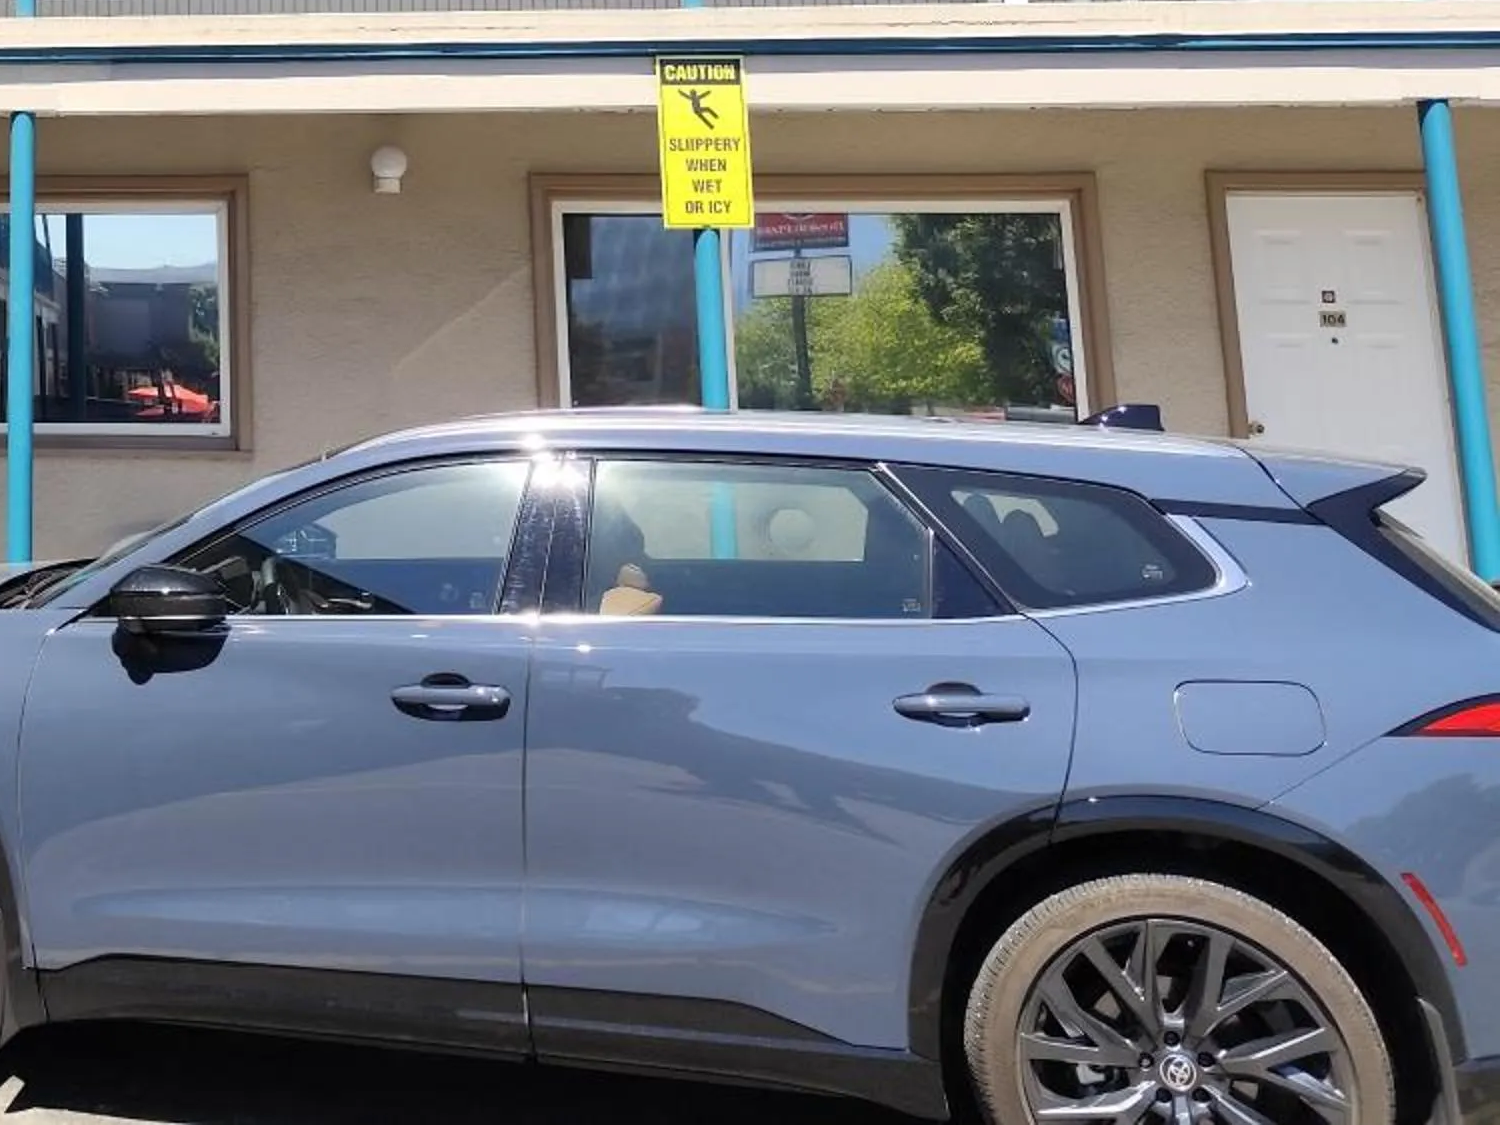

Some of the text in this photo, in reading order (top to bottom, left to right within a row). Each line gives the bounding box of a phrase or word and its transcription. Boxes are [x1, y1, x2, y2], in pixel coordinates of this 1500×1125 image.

[664, 64, 736, 81] CAUTION
[669, 137, 740, 152] SLIPPERY
[685, 158, 727, 172] WHEN
[692, 178, 722, 193] WET
[684, 200, 732, 214] OR ICY
